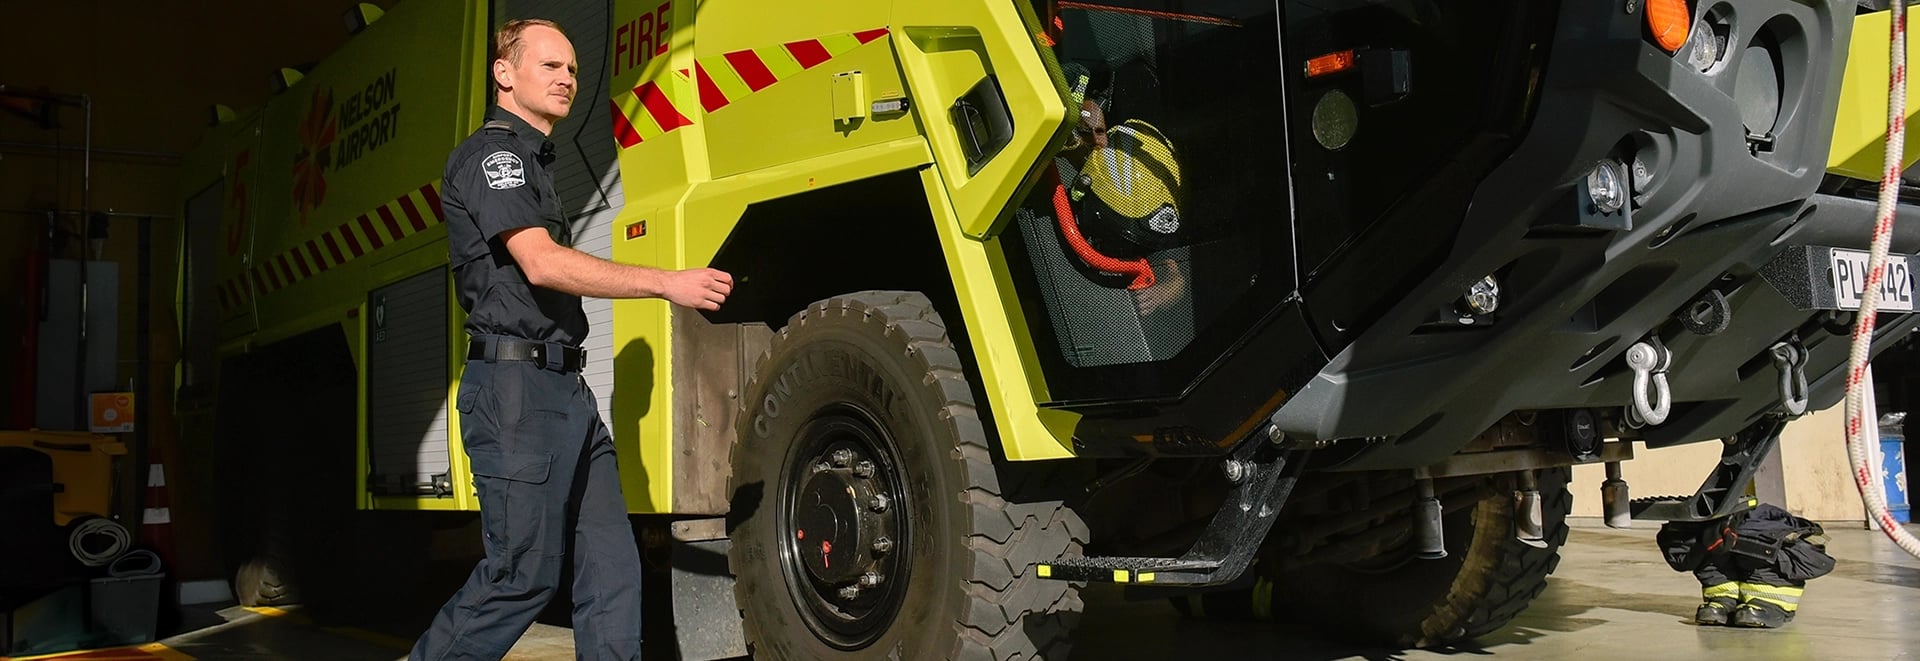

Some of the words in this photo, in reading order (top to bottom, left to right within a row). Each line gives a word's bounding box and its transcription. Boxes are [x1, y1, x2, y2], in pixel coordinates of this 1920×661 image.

[614, 1, 671, 77] FIRE
[338, 67, 396, 134] NELSON
[335, 101, 400, 171] AIRPORT
[228, 149, 248, 255] 5
[1836, 258, 1909, 302] PL442
